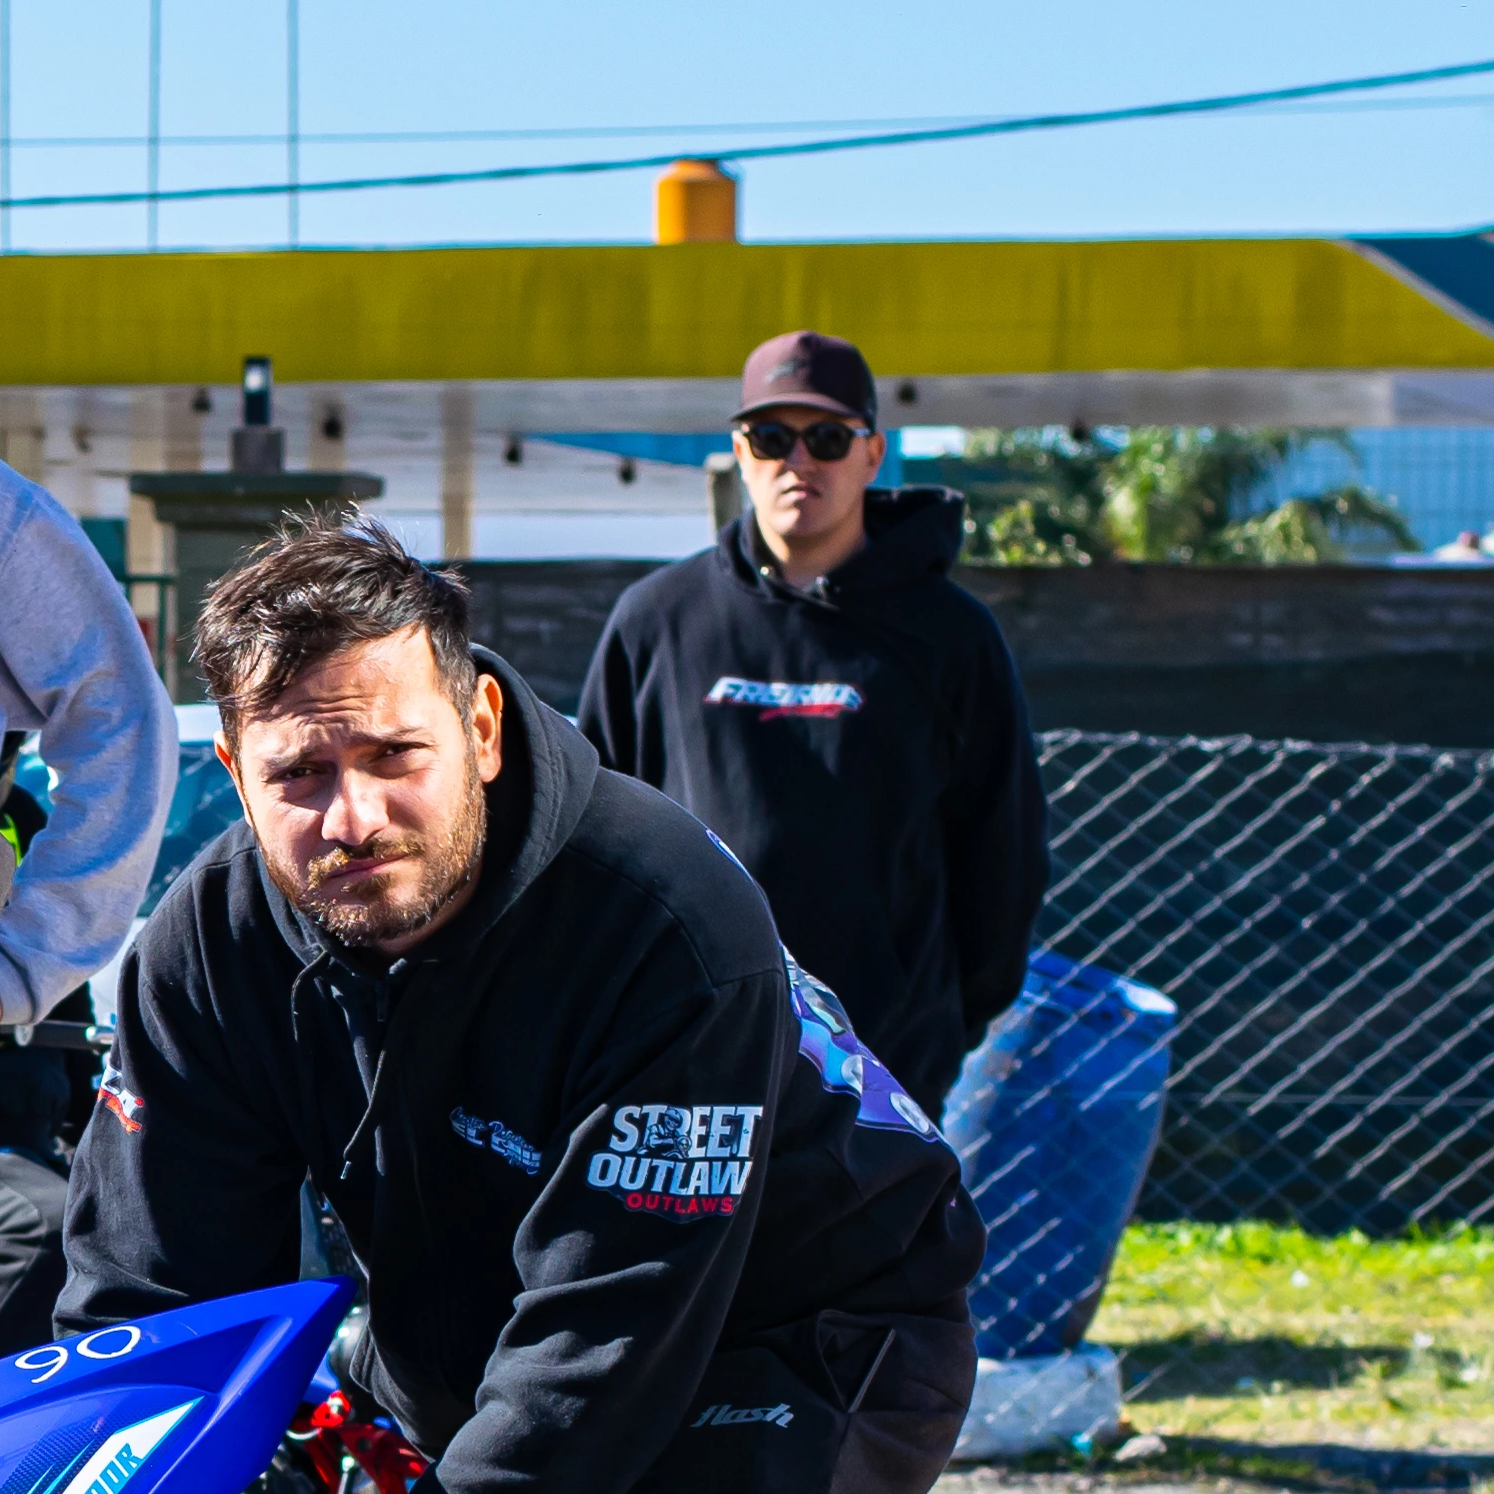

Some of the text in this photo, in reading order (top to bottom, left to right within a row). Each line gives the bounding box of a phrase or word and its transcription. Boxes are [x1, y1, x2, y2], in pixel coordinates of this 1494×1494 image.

[626, 1193, 734, 1214] OUTLAWS
[14, 1325, 142, 1384] 90
[689, 1403, 795, 1428] flash
